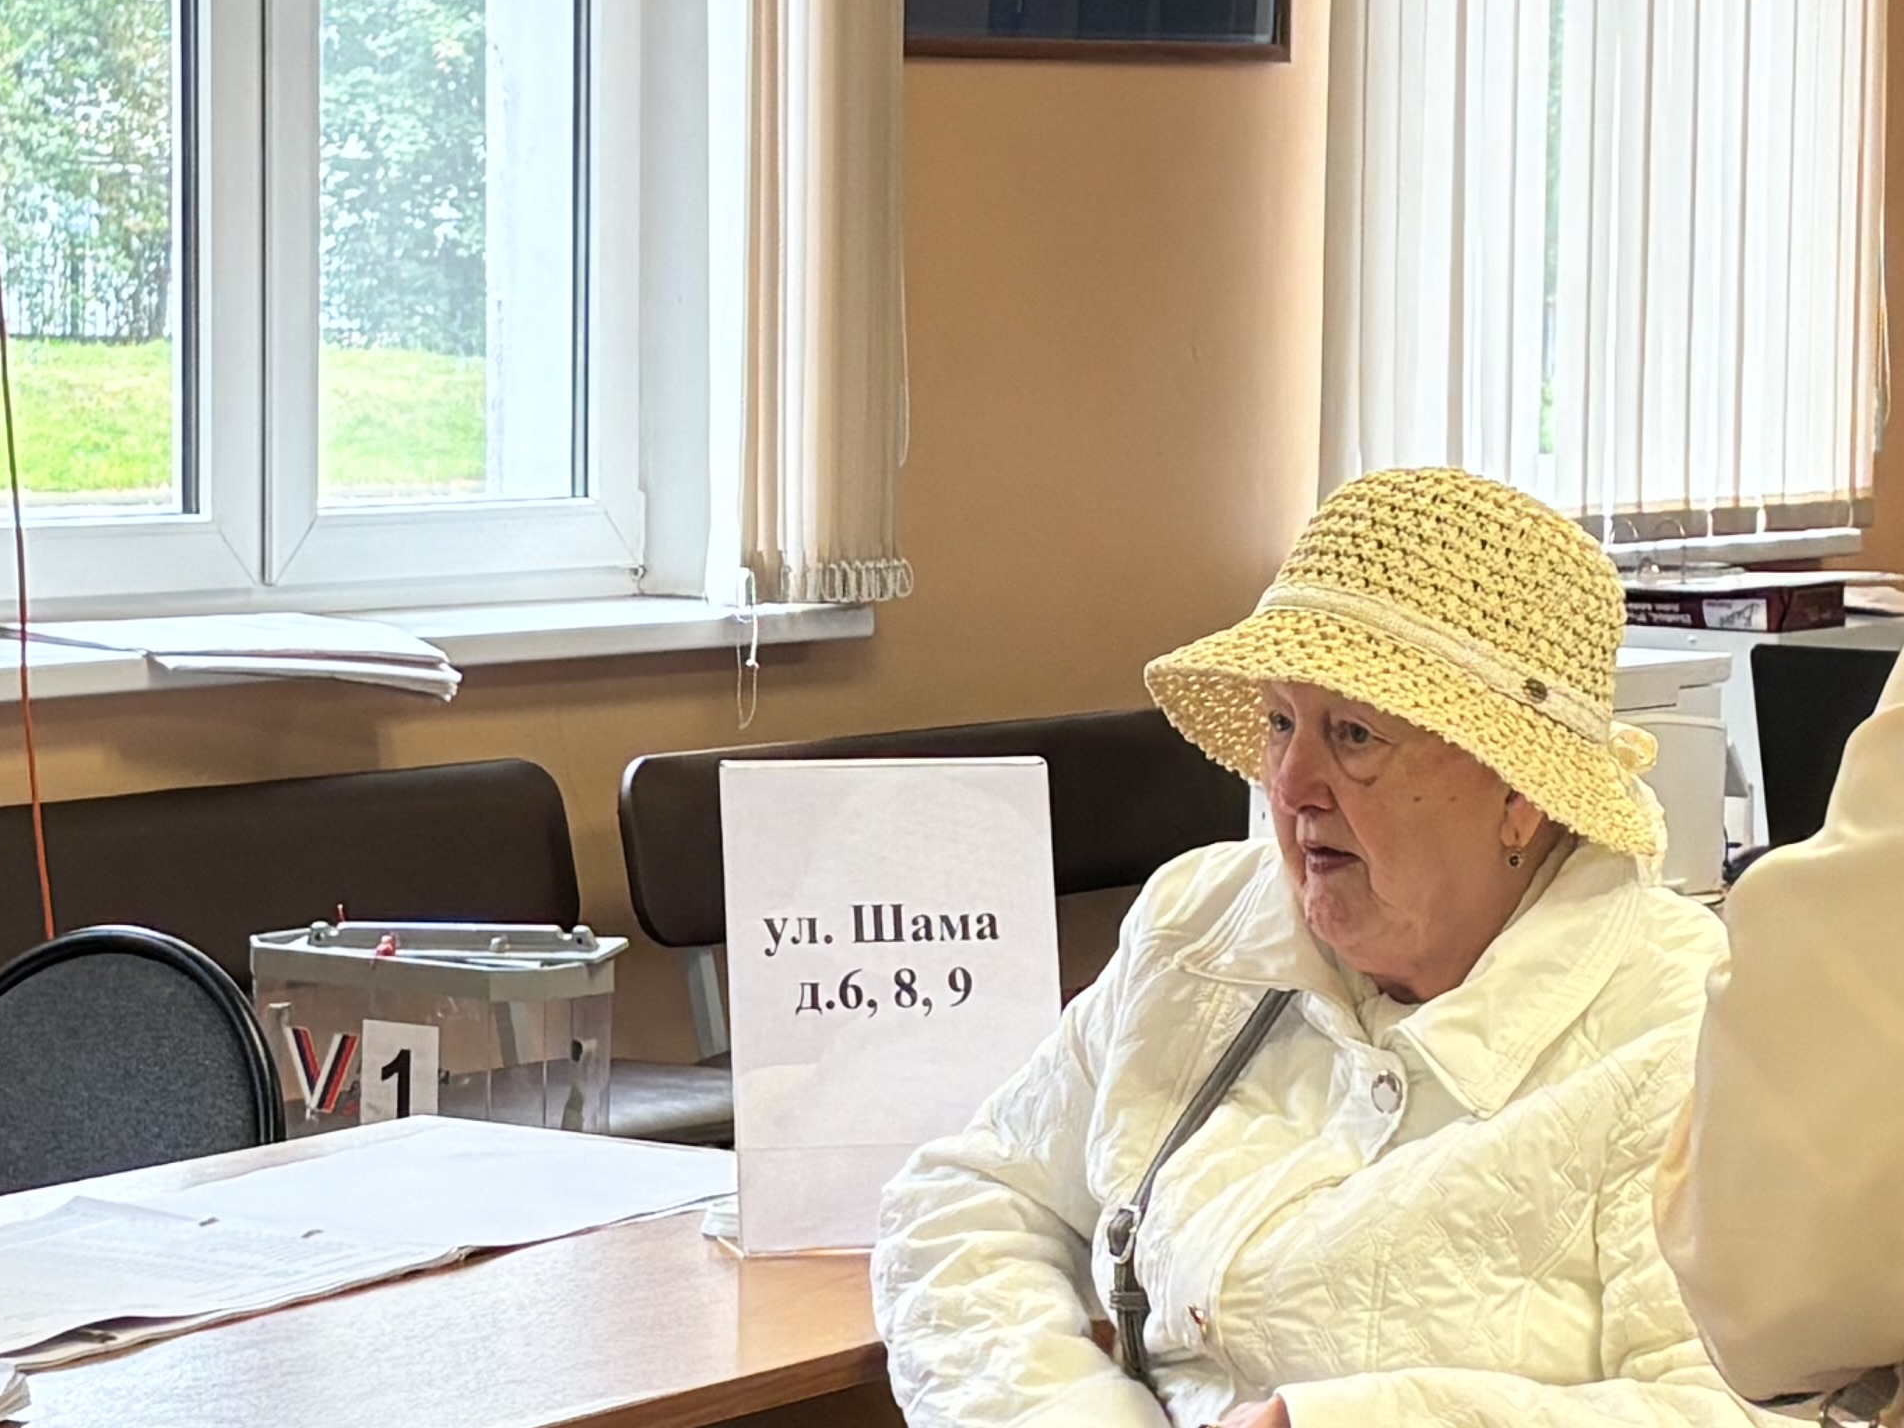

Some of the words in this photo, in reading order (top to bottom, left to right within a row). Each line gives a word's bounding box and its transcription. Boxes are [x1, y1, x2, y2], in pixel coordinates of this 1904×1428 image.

[763, 916, 834, 957] ул.
[852, 903, 1000, 944] Шама
[795, 969, 878, 1017] д.6,
[894, 968, 933, 1016] 8,
[948, 966, 973, 1007] 9
[381, 1048, 411, 1119] 1
